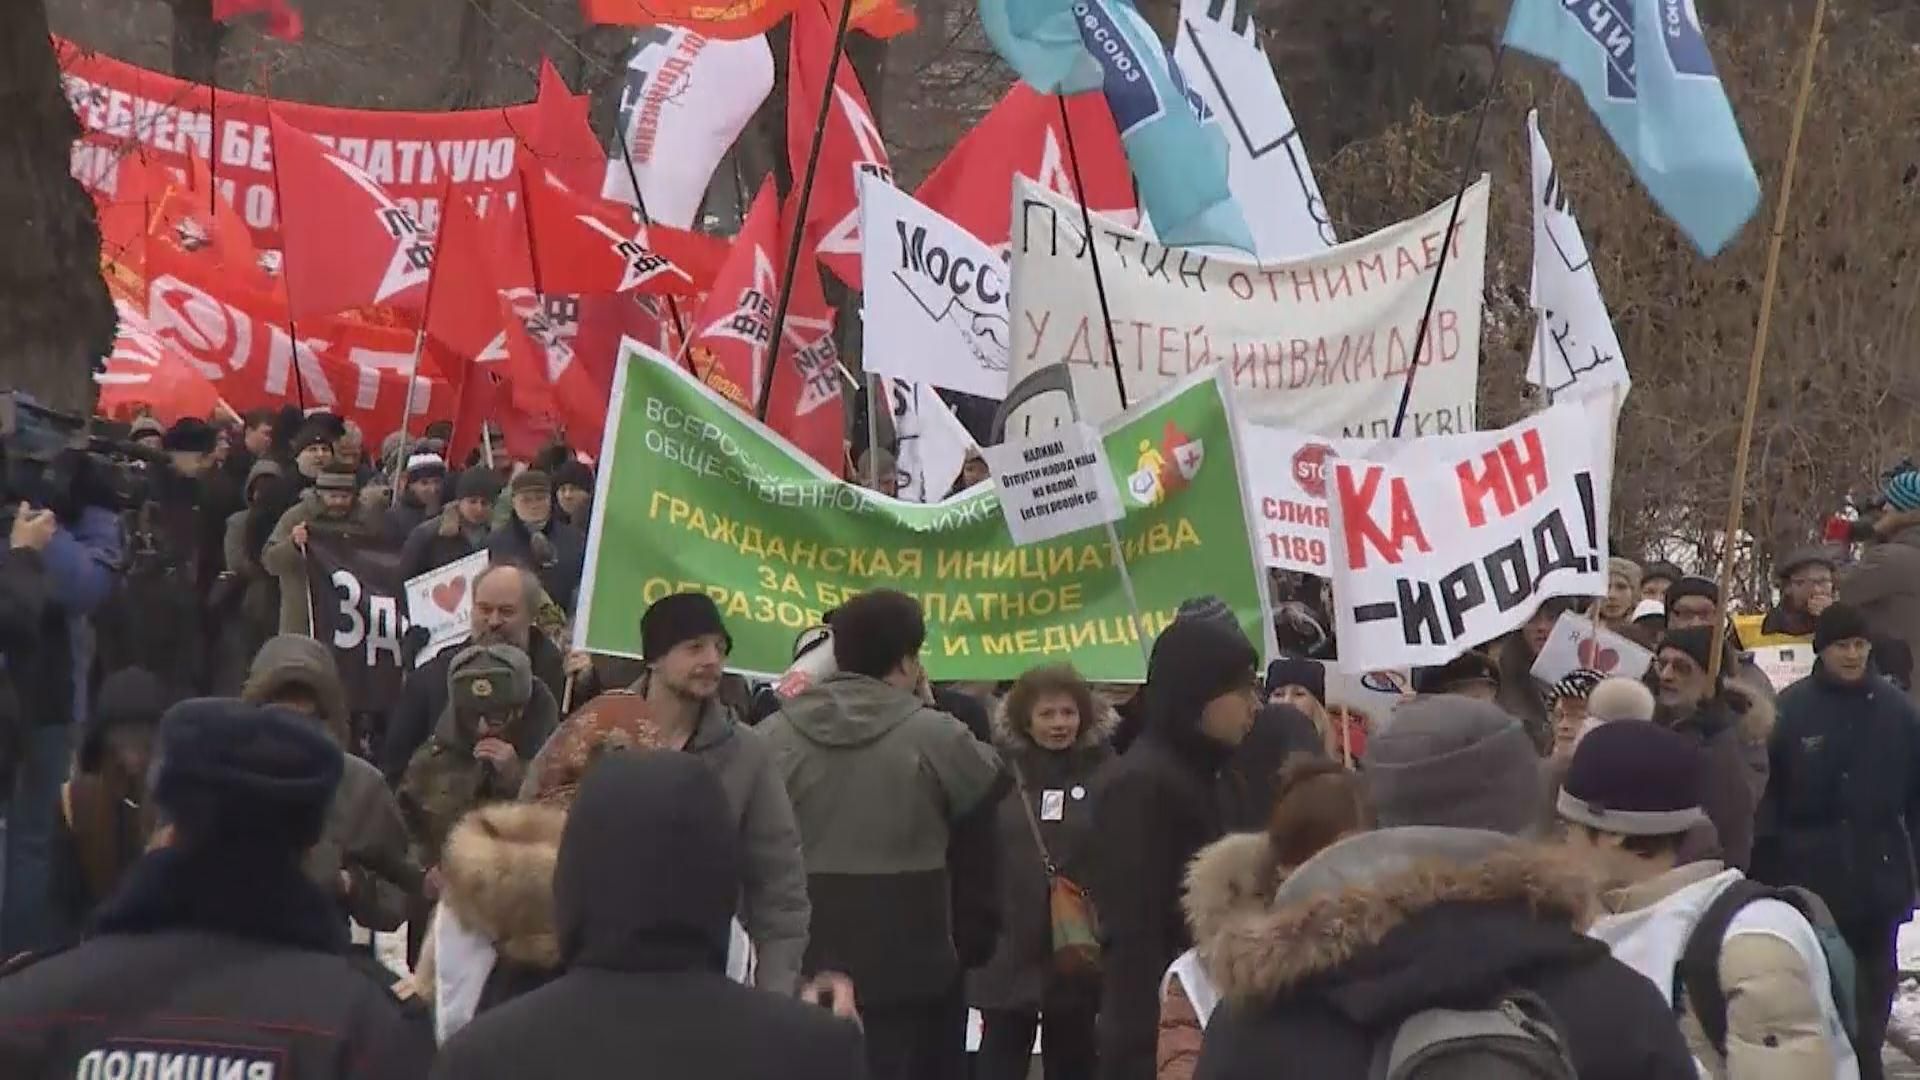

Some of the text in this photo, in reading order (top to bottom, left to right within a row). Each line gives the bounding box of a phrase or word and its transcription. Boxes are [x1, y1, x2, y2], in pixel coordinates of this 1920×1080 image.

[1073, 1, 1141, 83] ОФСОЮЗ
[62, 72, 213, 158] РЕБУЕМ
[1025, 309, 1050, 361] У
[649, 490, 1202, 581] ГРАЖДАНСКАЯ ИНИЦИАТИВА
[1262, 496, 1330, 529] СЛИЯ
[757, 565, 806, 599] ЗА
[943, 634, 970, 656] И
[980, 607, 1179, 655] МЕДИЦИН
[76, 1049, 275, 1080] ПОЛИЦИЯ
